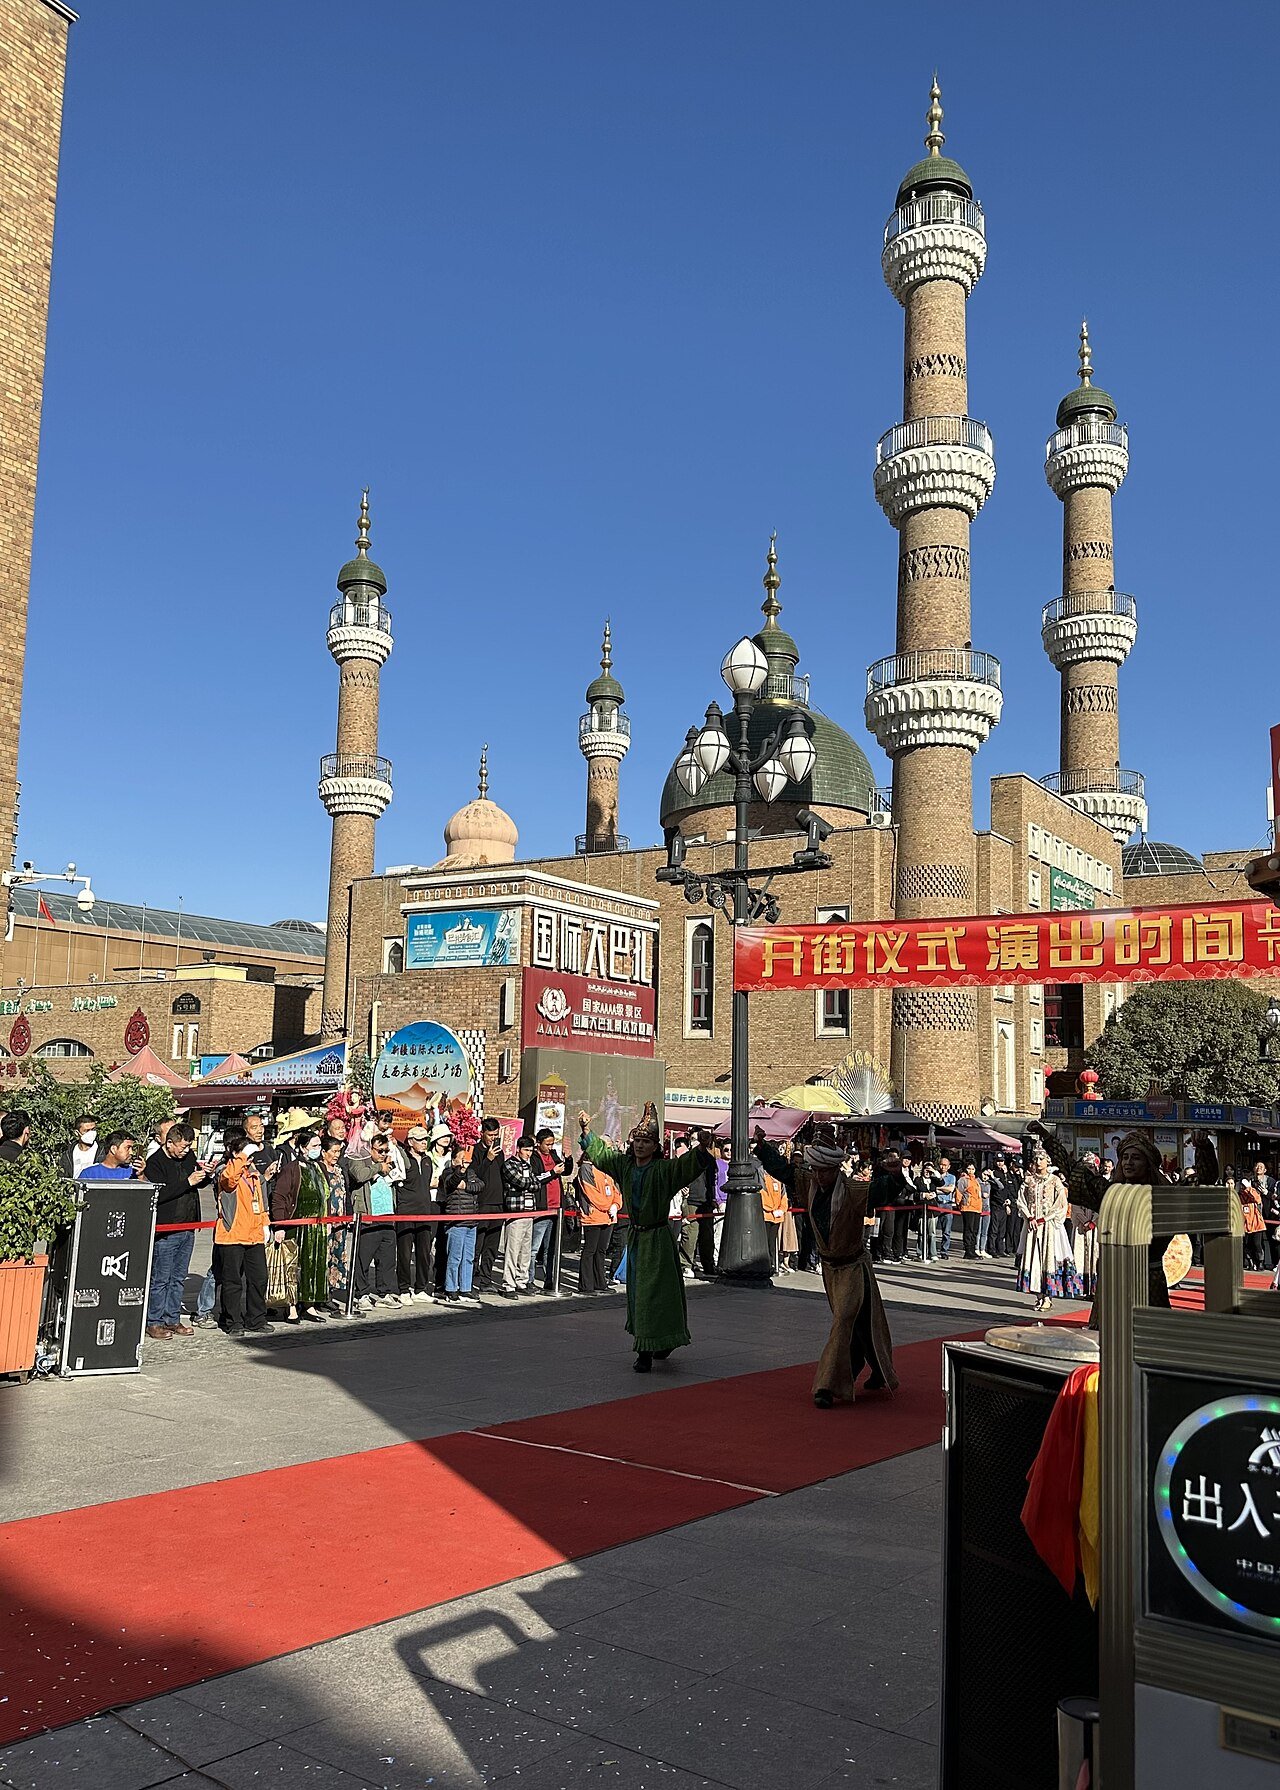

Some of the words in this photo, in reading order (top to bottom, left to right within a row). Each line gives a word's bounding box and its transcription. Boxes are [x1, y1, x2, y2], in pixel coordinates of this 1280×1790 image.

[533, 908, 653, 984] 国际大巴扎
[761, 926, 967, 978] 开街仪式
[390, 1043, 455, 1056] 新疆国际大巴扎
[1182, 1474, 1280, 1538] 出入
[1236, 1558, 1280, 1575] 中国
